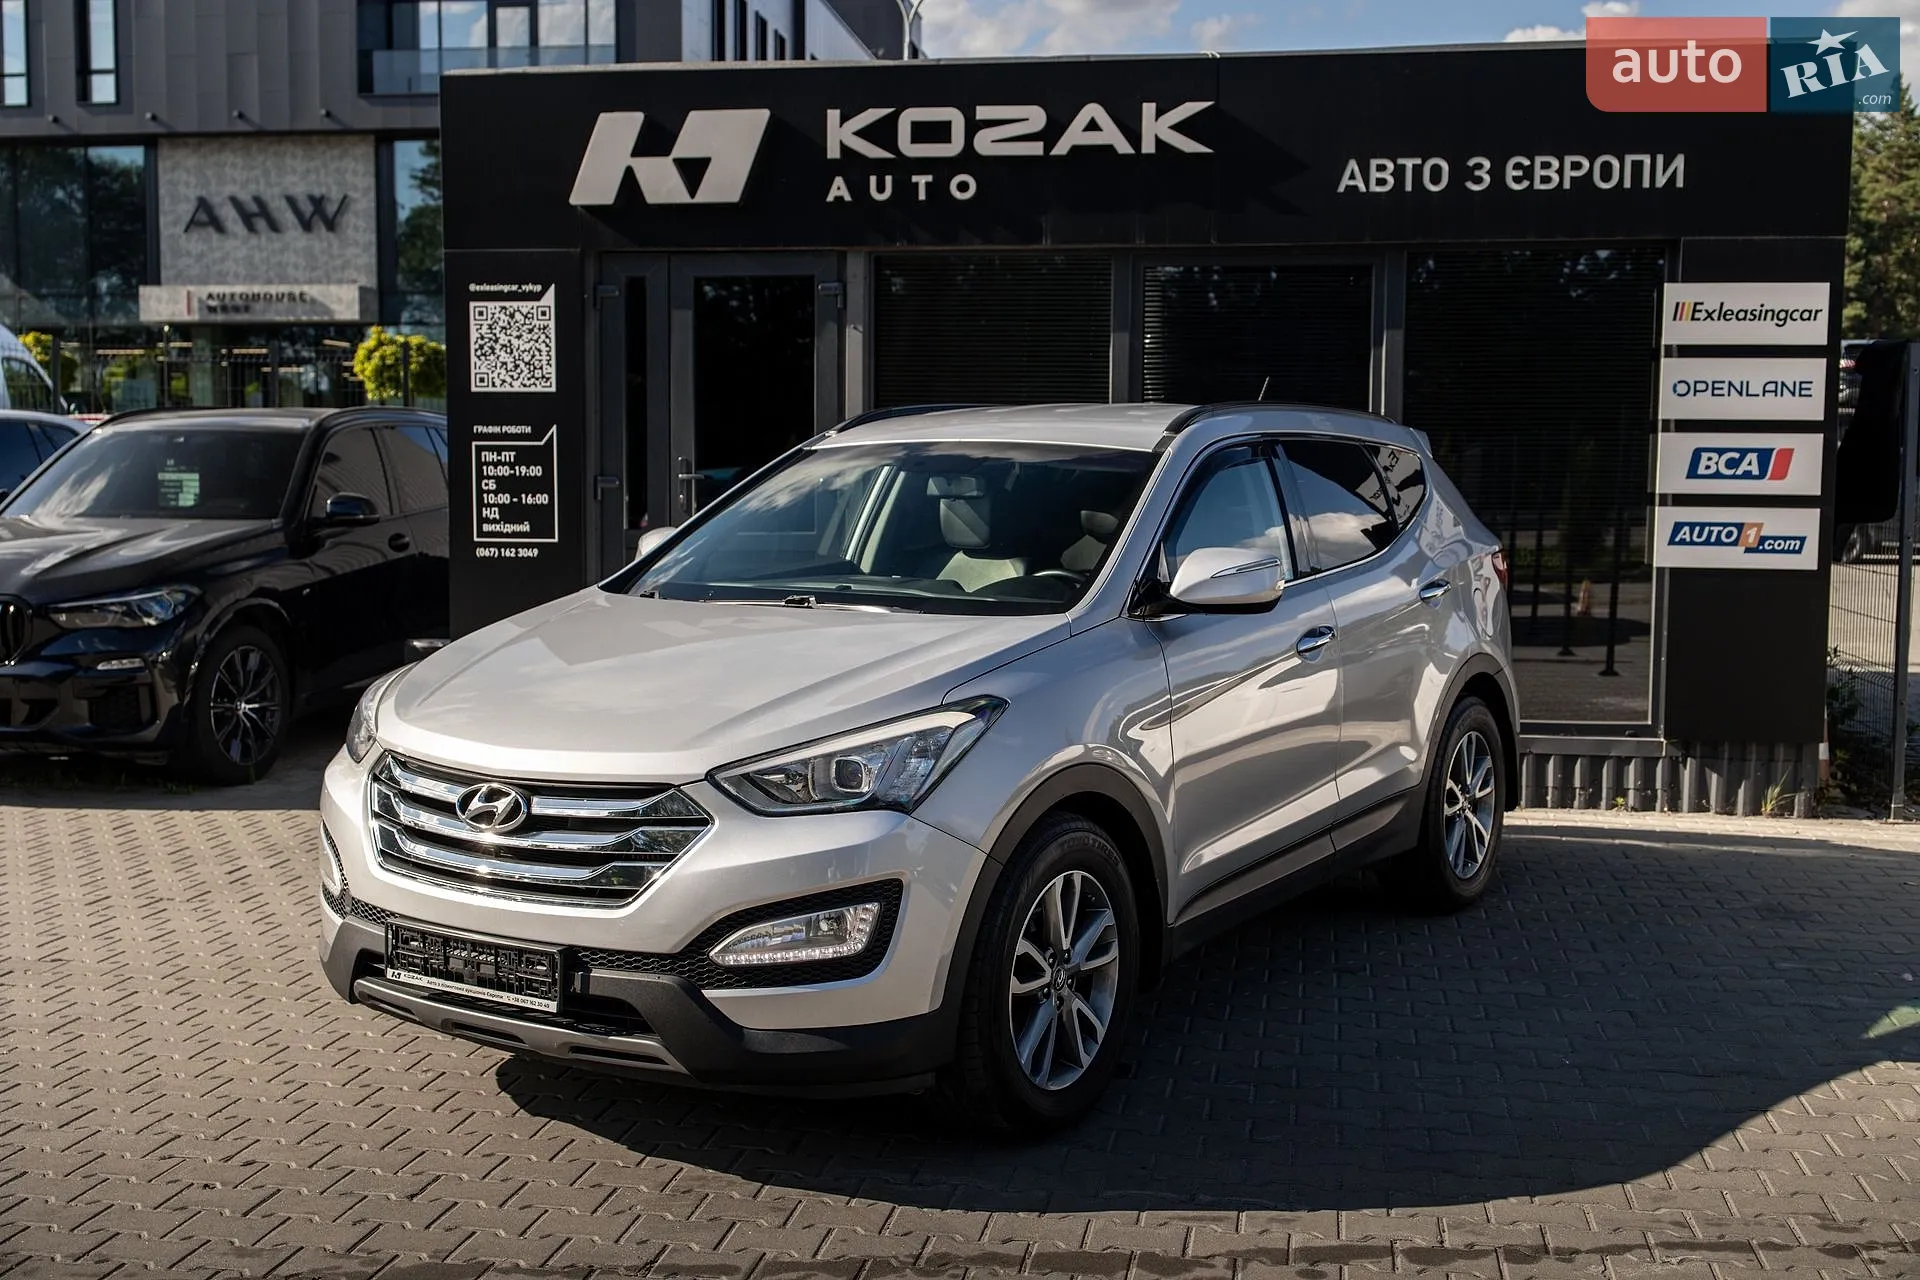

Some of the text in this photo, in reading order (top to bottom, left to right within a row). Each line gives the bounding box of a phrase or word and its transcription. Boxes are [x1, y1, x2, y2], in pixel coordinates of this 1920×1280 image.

[825, 101, 1216, 159] KOZAK
[1337, 157, 1450, 193] АВТО
[1504, 153, 1686, 190] ЄВРОПИ
[825, 173, 977, 202] AUTO
[183, 194, 349, 234] AHW
[205, 291, 310, 303] AUTOHOUSE
[1690, 301, 1823, 328] Exleasingcar
[1672, 379, 1814, 398] OPENLANE
[473, 425, 532, 434] ГРАФІК РОБОТИ
[481, 451, 516, 462] ПН-ПТ
[482, 465, 542, 476] 10:00-19:00
[1696, 452, 1760, 476] BCA
[481, 479, 496, 490] СБ
[482, 493, 510, 504] 10:00
[520, 493, 549, 504] 16:00
[482, 507, 499, 520] НД
[482, 521, 530, 534] вихідний
[475, 547, 539, 558] (067) 162 3049
